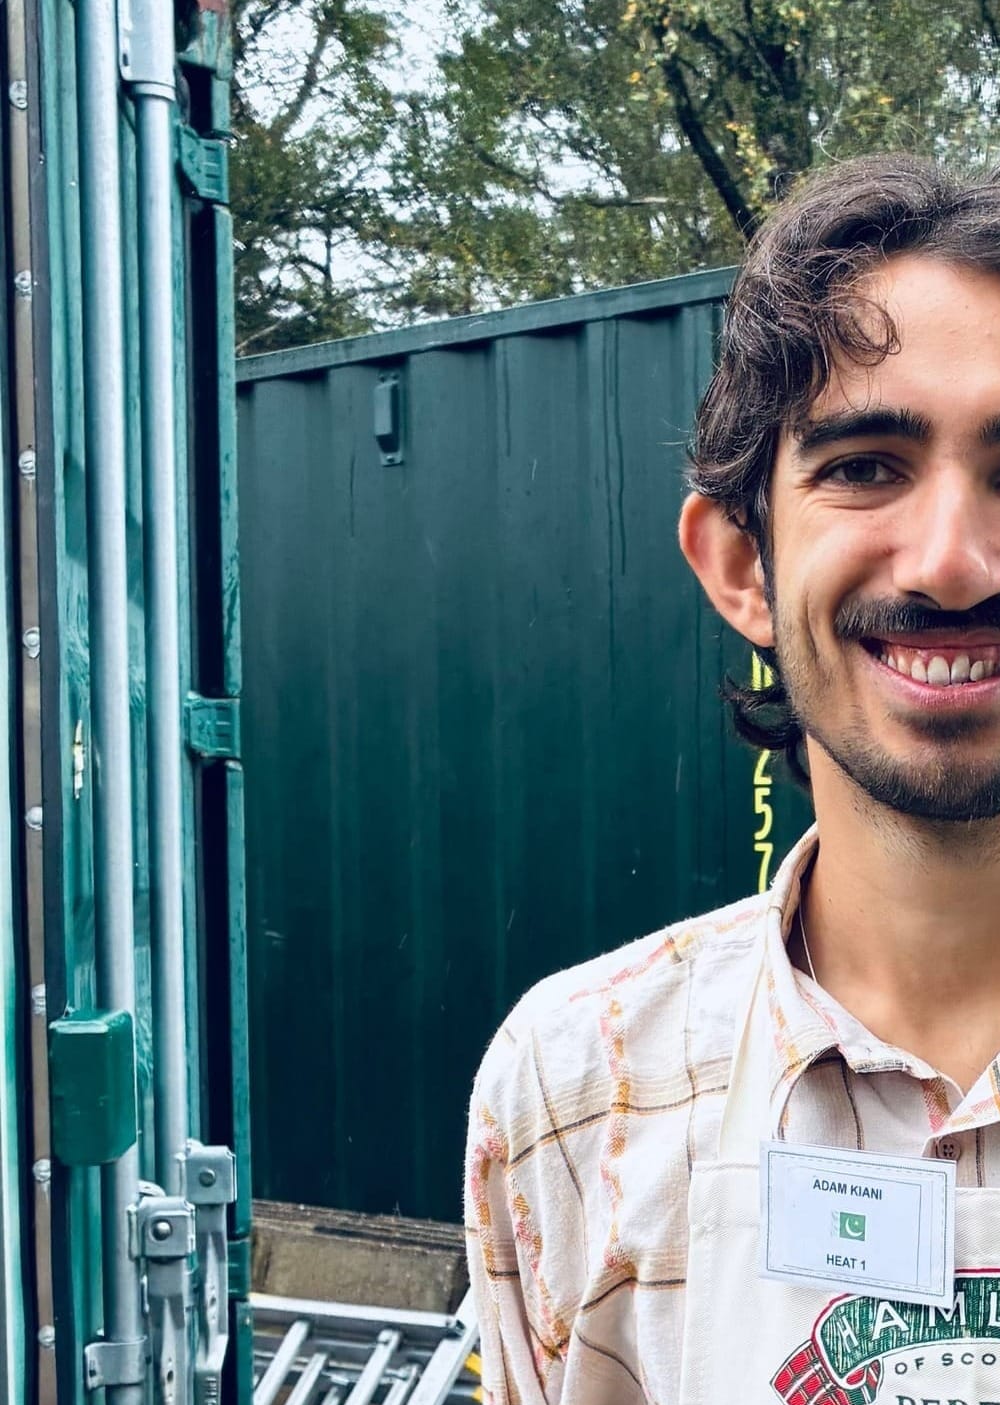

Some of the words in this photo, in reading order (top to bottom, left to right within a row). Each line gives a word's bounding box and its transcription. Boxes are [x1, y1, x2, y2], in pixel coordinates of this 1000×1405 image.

[813, 1178, 847, 1195] ADAM
[850, 1185, 883, 1200] KIANI
[826, 1253, 857, 1270] HEAT
[860, 1260, 867, 1271] 1
[894, 1357, 925, 1375] OF
